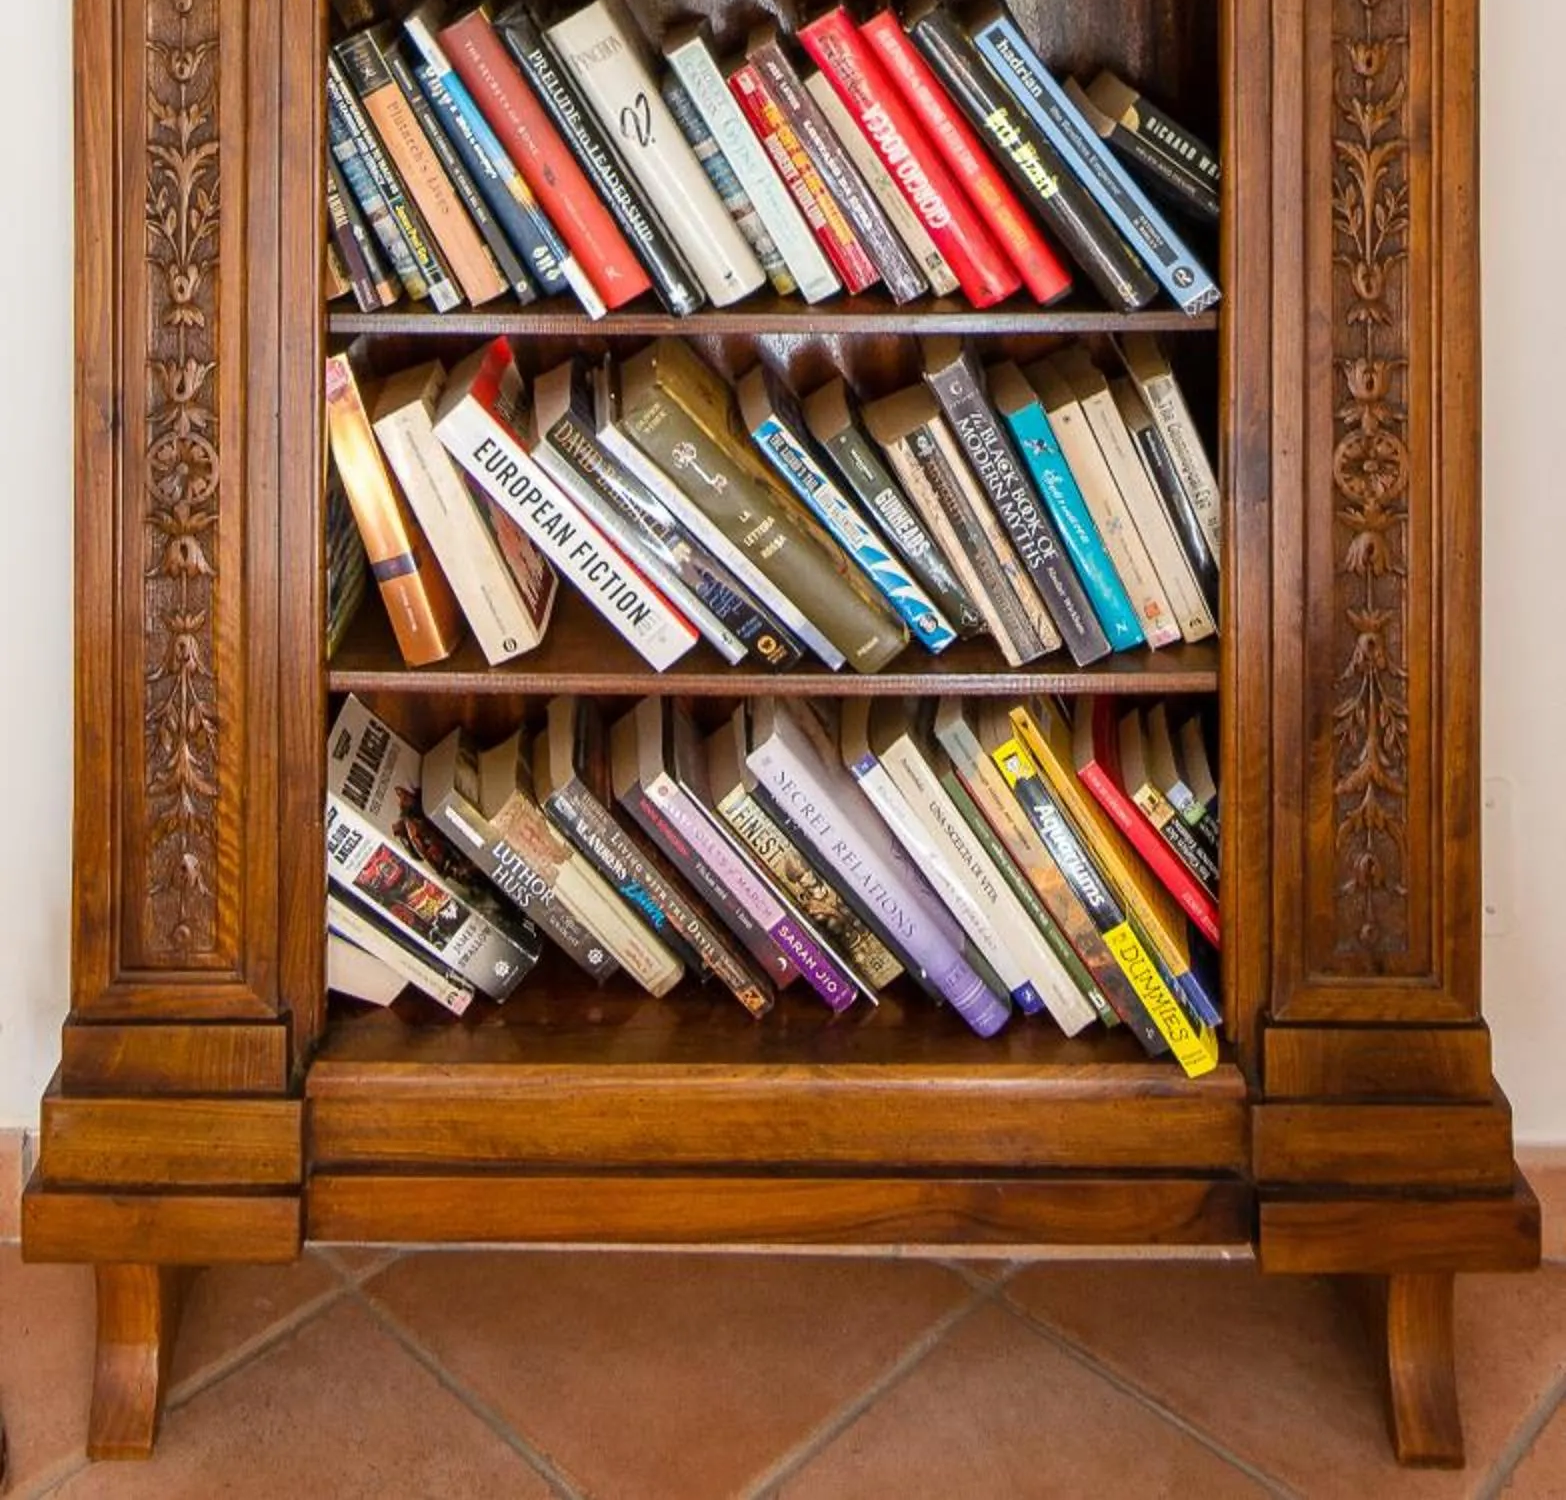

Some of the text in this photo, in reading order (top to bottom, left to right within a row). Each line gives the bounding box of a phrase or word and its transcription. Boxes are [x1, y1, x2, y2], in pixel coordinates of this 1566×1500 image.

[996, 36, 1044, 99] hadrian
[386, 101, 432, 173] Plutarch's
[527, 48, 582, 135] PRELUDE
[588, 147, 656, 245] LEADERSHIP
[860, 102, 910, 165] BOCCA
[1145, 116, 1196, 164] RICHARD
[896, 156, 951, 231] GIORGIO
[553, 418, 604, 475] DAVID
[875, 486, 932, 560] GUNHEADS
[957, 417, 1047, 571] MODERN MYTHS
[980, 424, 1019, 484] BLACK
[1012, 482, 1045, 538] BOOK
[1038, 526, 1058, 561] OF
[473, 437, 577, 548] EUROPEAN
[569, 540, 652, 628] FICTION
[734, 804, 786, 864] FINEST
[773, 769, 918, 941] SECRET RELATIONS
[940, 822, 977, 867] SCELTA
[976, 875, 1002, 904] VITA
[1034, 801, 1106, 910] Aquariums
[491, 867, 535, 909] HUSS
[492, 840, 556, 905] LUTHOR
[777, 924, 840, 994] SARAH JIO
[1117, 940, 1191, 1045] DUMMIES
